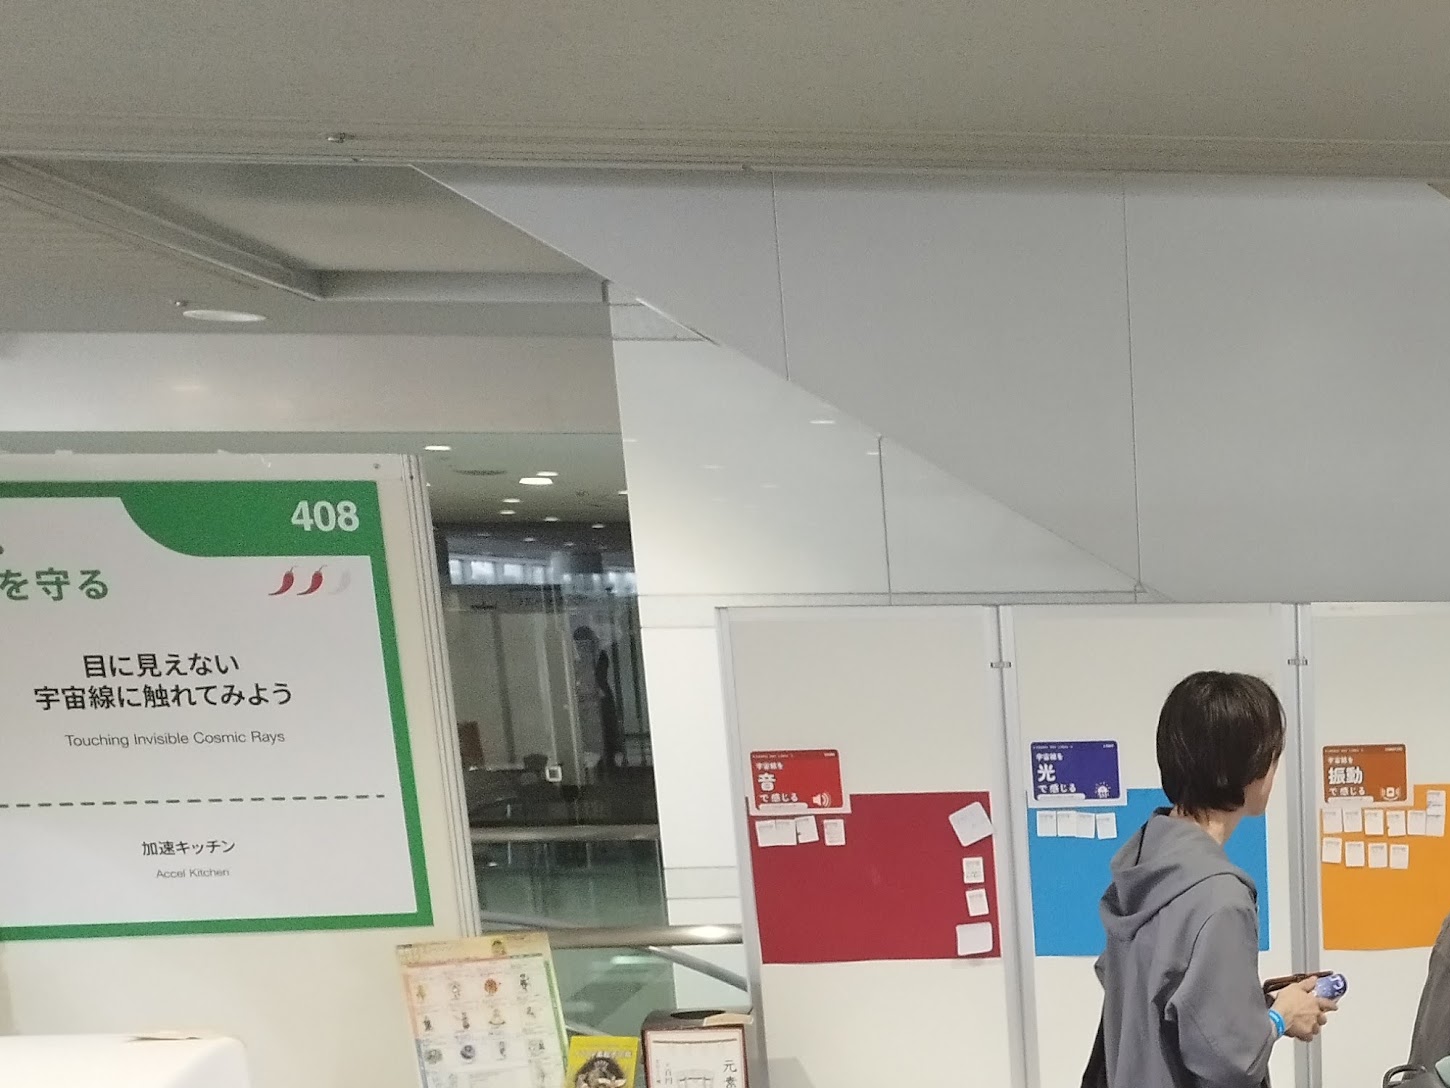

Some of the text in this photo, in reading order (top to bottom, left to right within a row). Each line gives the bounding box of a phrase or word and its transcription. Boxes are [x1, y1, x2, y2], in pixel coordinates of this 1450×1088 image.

[291, 501, 360, 532] 408
[0, 568, 109, 601] を守る
[83, 652, 240, 679] 目に見えない
[33, 684, 293, 711] 宇宙線に触れてみよう
[65, 730, 286, 748] Touching Invisible Cosmic Rays
[758, 772, 776, 791] 音
[1037, 763, 1056, 782] 光
[1328, 766, 1363, 784] 振動
[760, 792, 798, 802] で感じる
[1038, 783, 1076, 793] で感じる
[141, 839, 236, 856] 加速キッチン
[156, 867, 230, 879] Accel Kitchen
